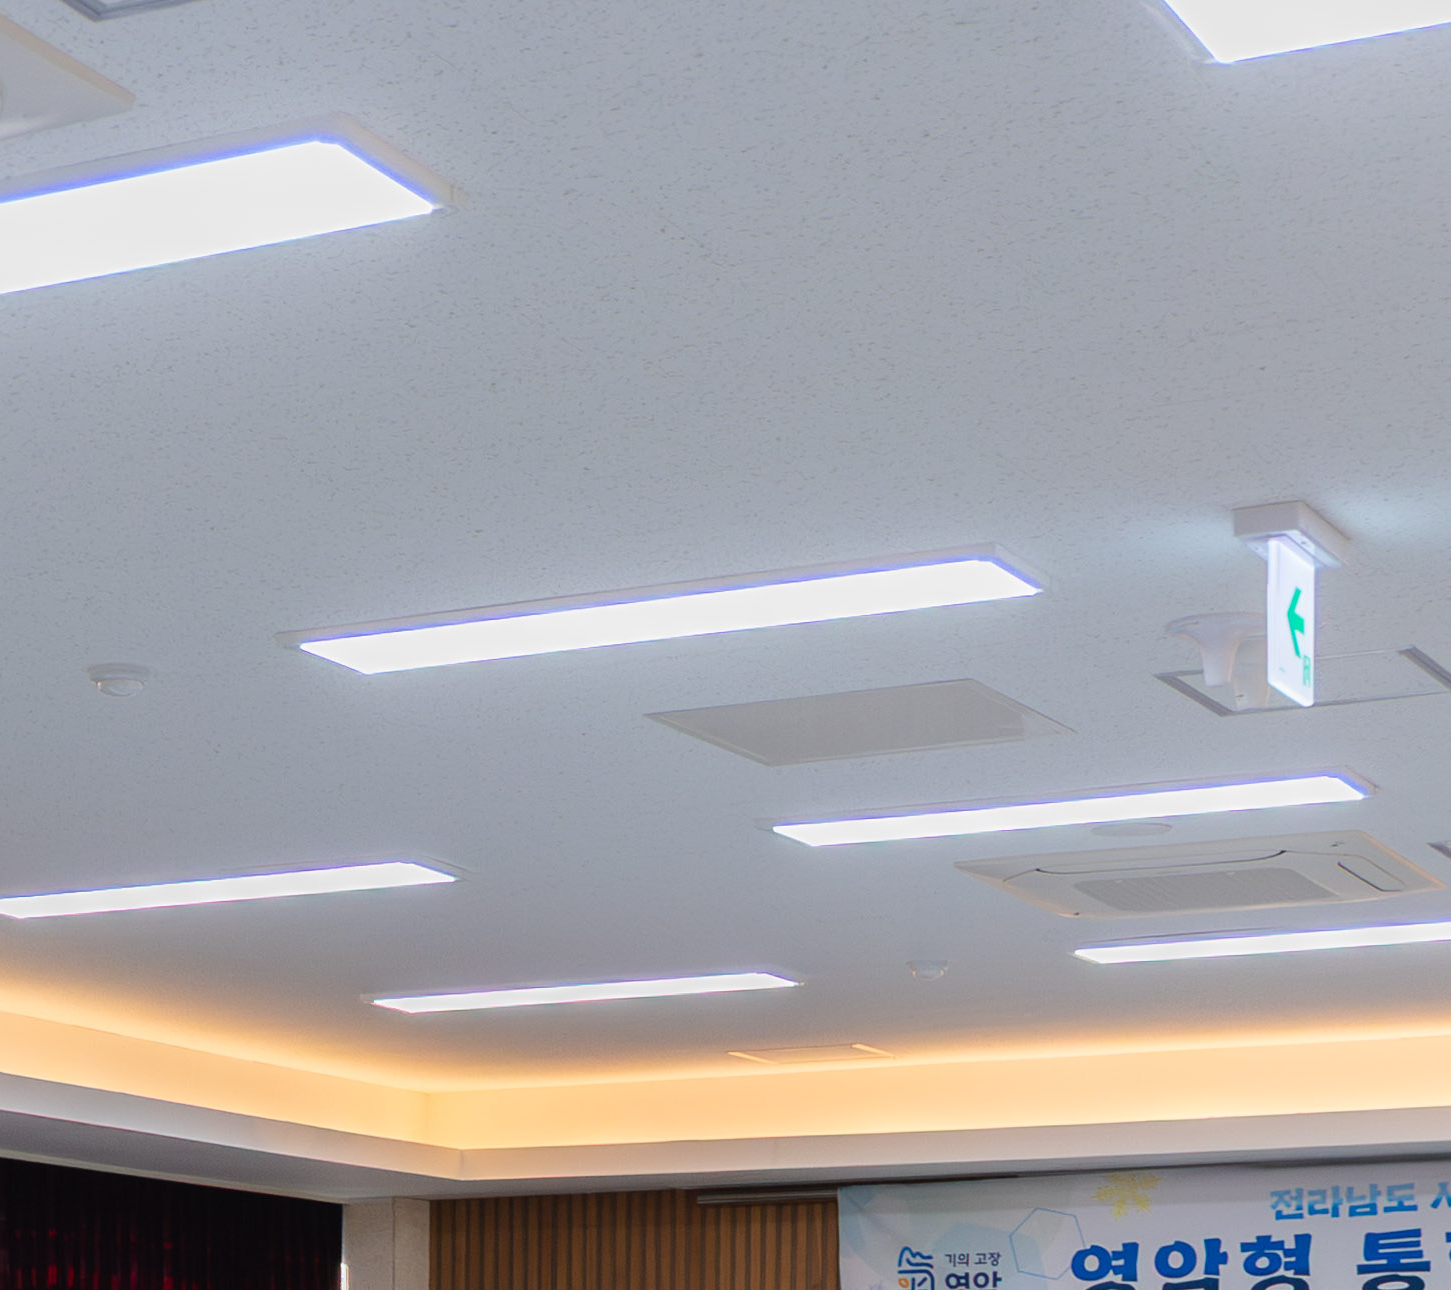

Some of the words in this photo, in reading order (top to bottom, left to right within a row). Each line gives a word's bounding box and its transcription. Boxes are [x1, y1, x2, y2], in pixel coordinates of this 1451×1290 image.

[1269, 1183, 1418, 1221] 전라남도
[945, 1253, 970, 1267] 기의
[974, 1252, 1002, 1267] 고장
